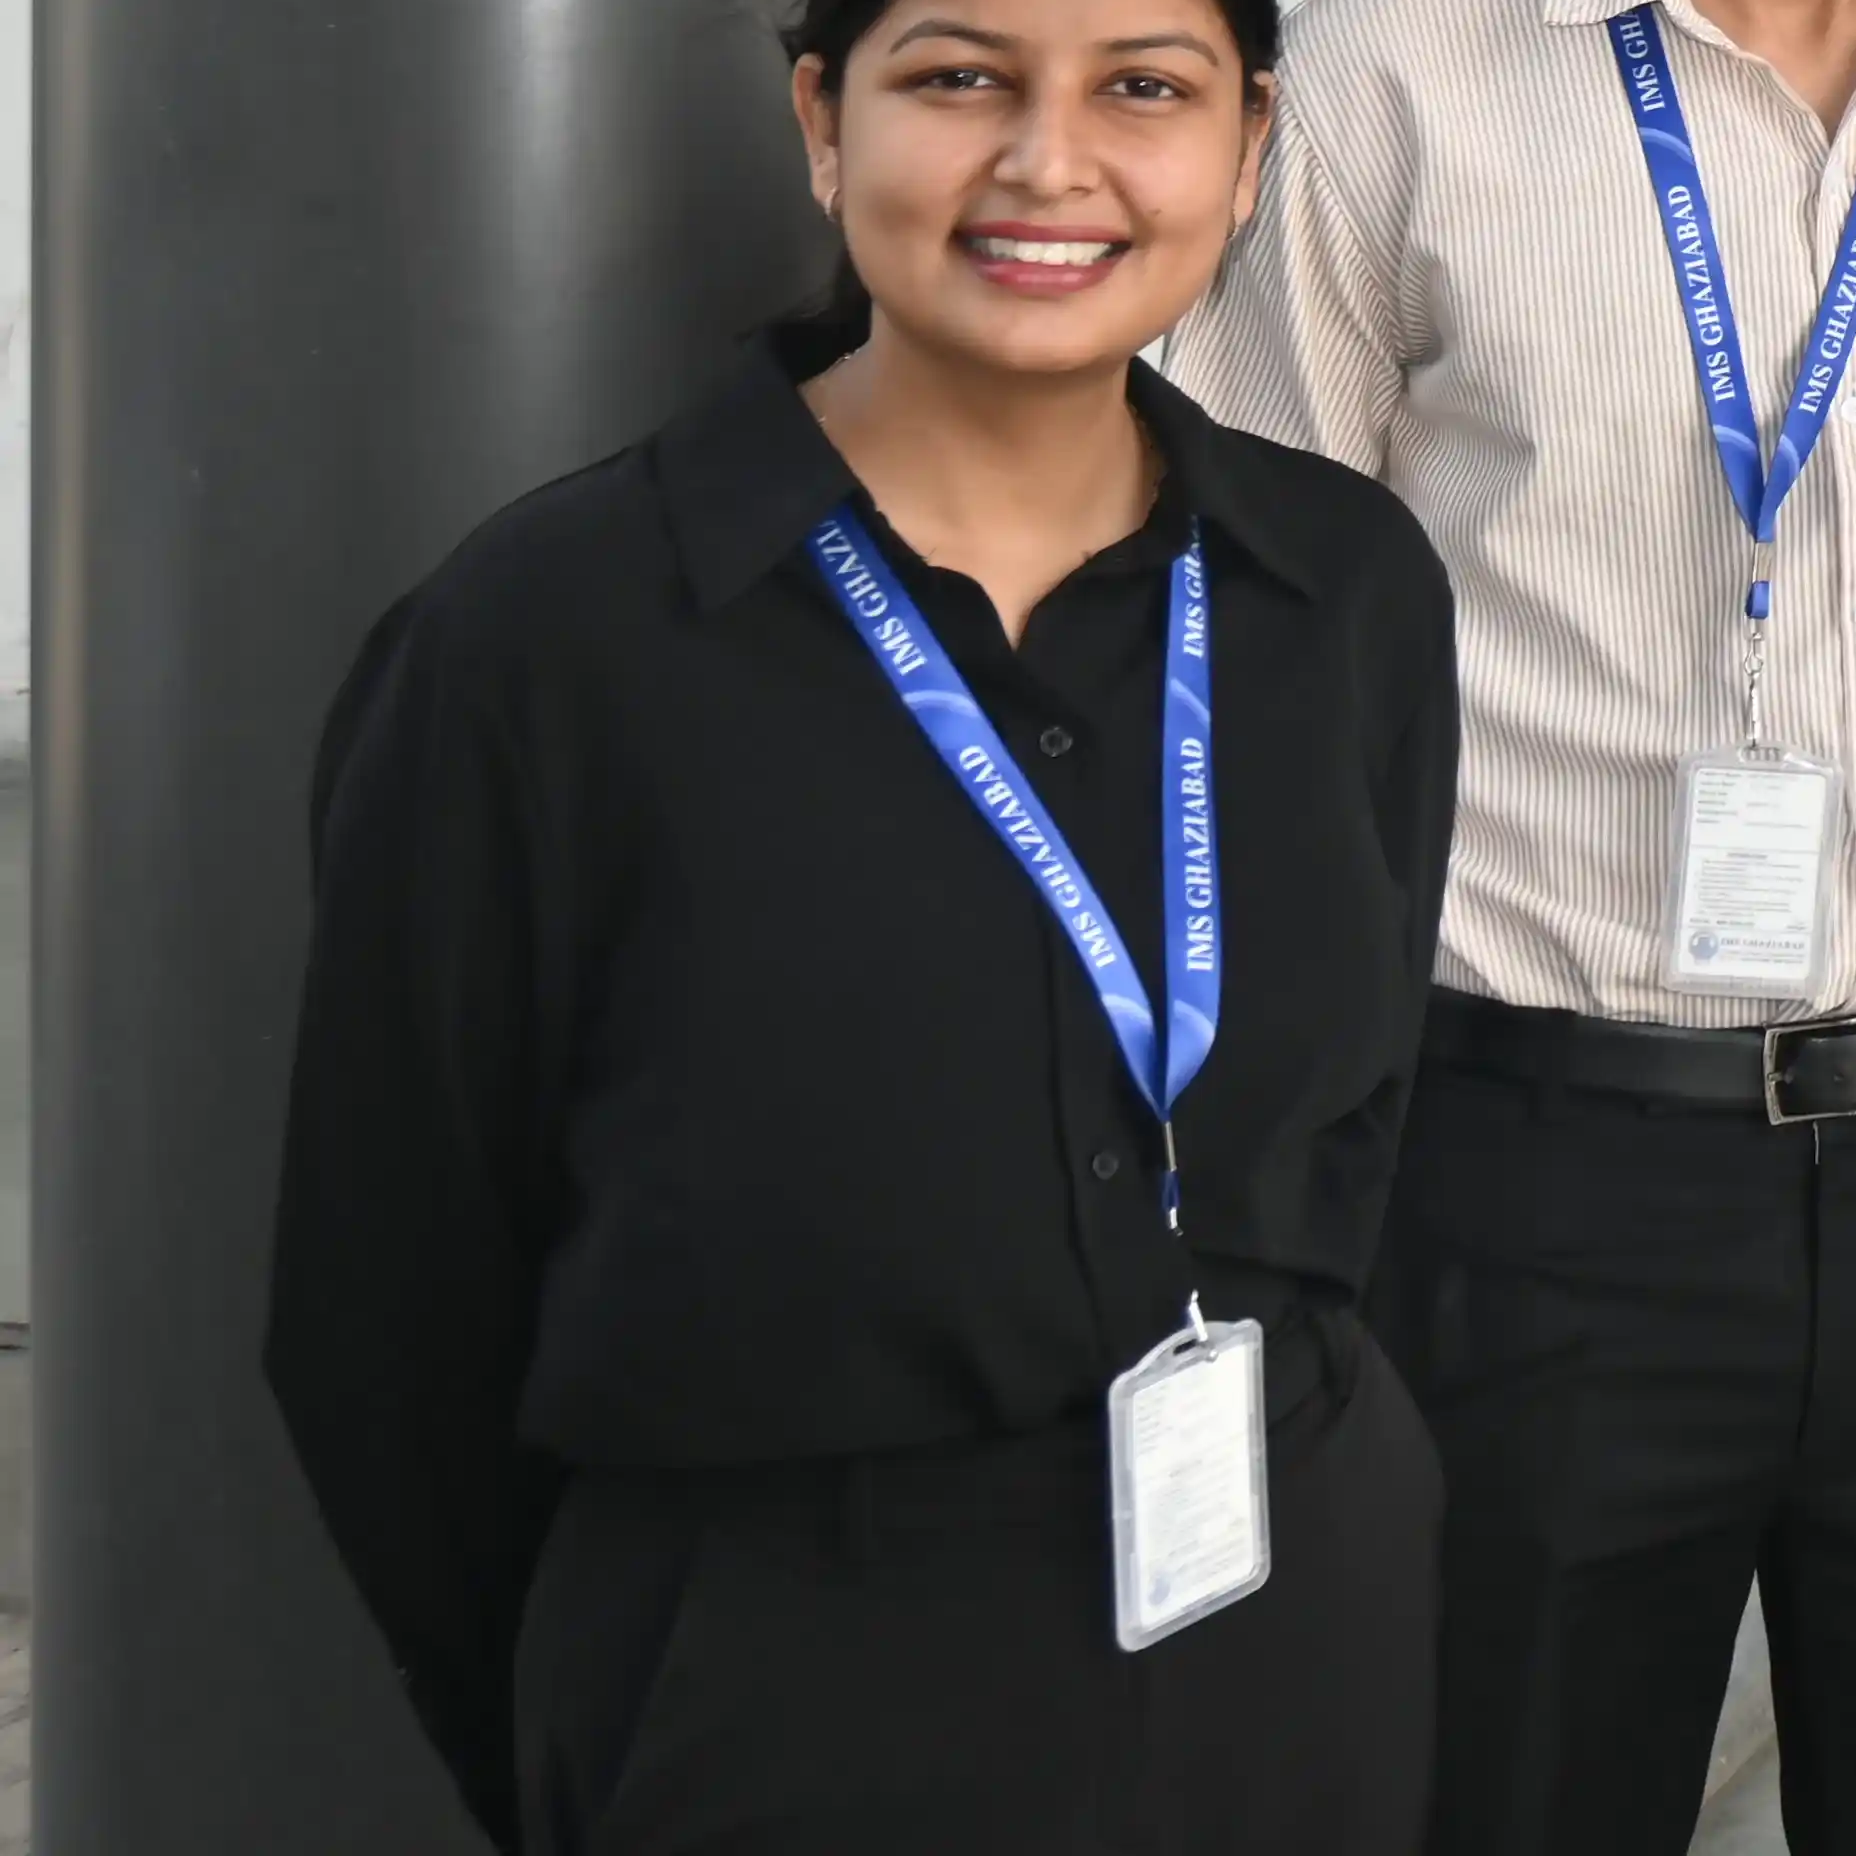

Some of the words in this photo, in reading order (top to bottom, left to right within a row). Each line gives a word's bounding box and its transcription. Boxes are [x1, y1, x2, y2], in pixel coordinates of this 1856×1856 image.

[1632, 63, 1666, 113] IMS
[1667, 185, 1724, 345] GHAZIABAD
[1705, 353, 1735, 401] IMS
[1798, 362, 1836, 414] IMS
[816, 520, 889, 618] GHAZI
[873, 616, 928, 676] IMS
[1183, 603, 1205, 658] IMS
[959, 745, 1081, 908] GHAZIABAD
[1180, 737, 1213, 909] GHAZIABAD
[1072, 911, 1117, 969] IMS
[1186, 915, 1214, 971] IMS
